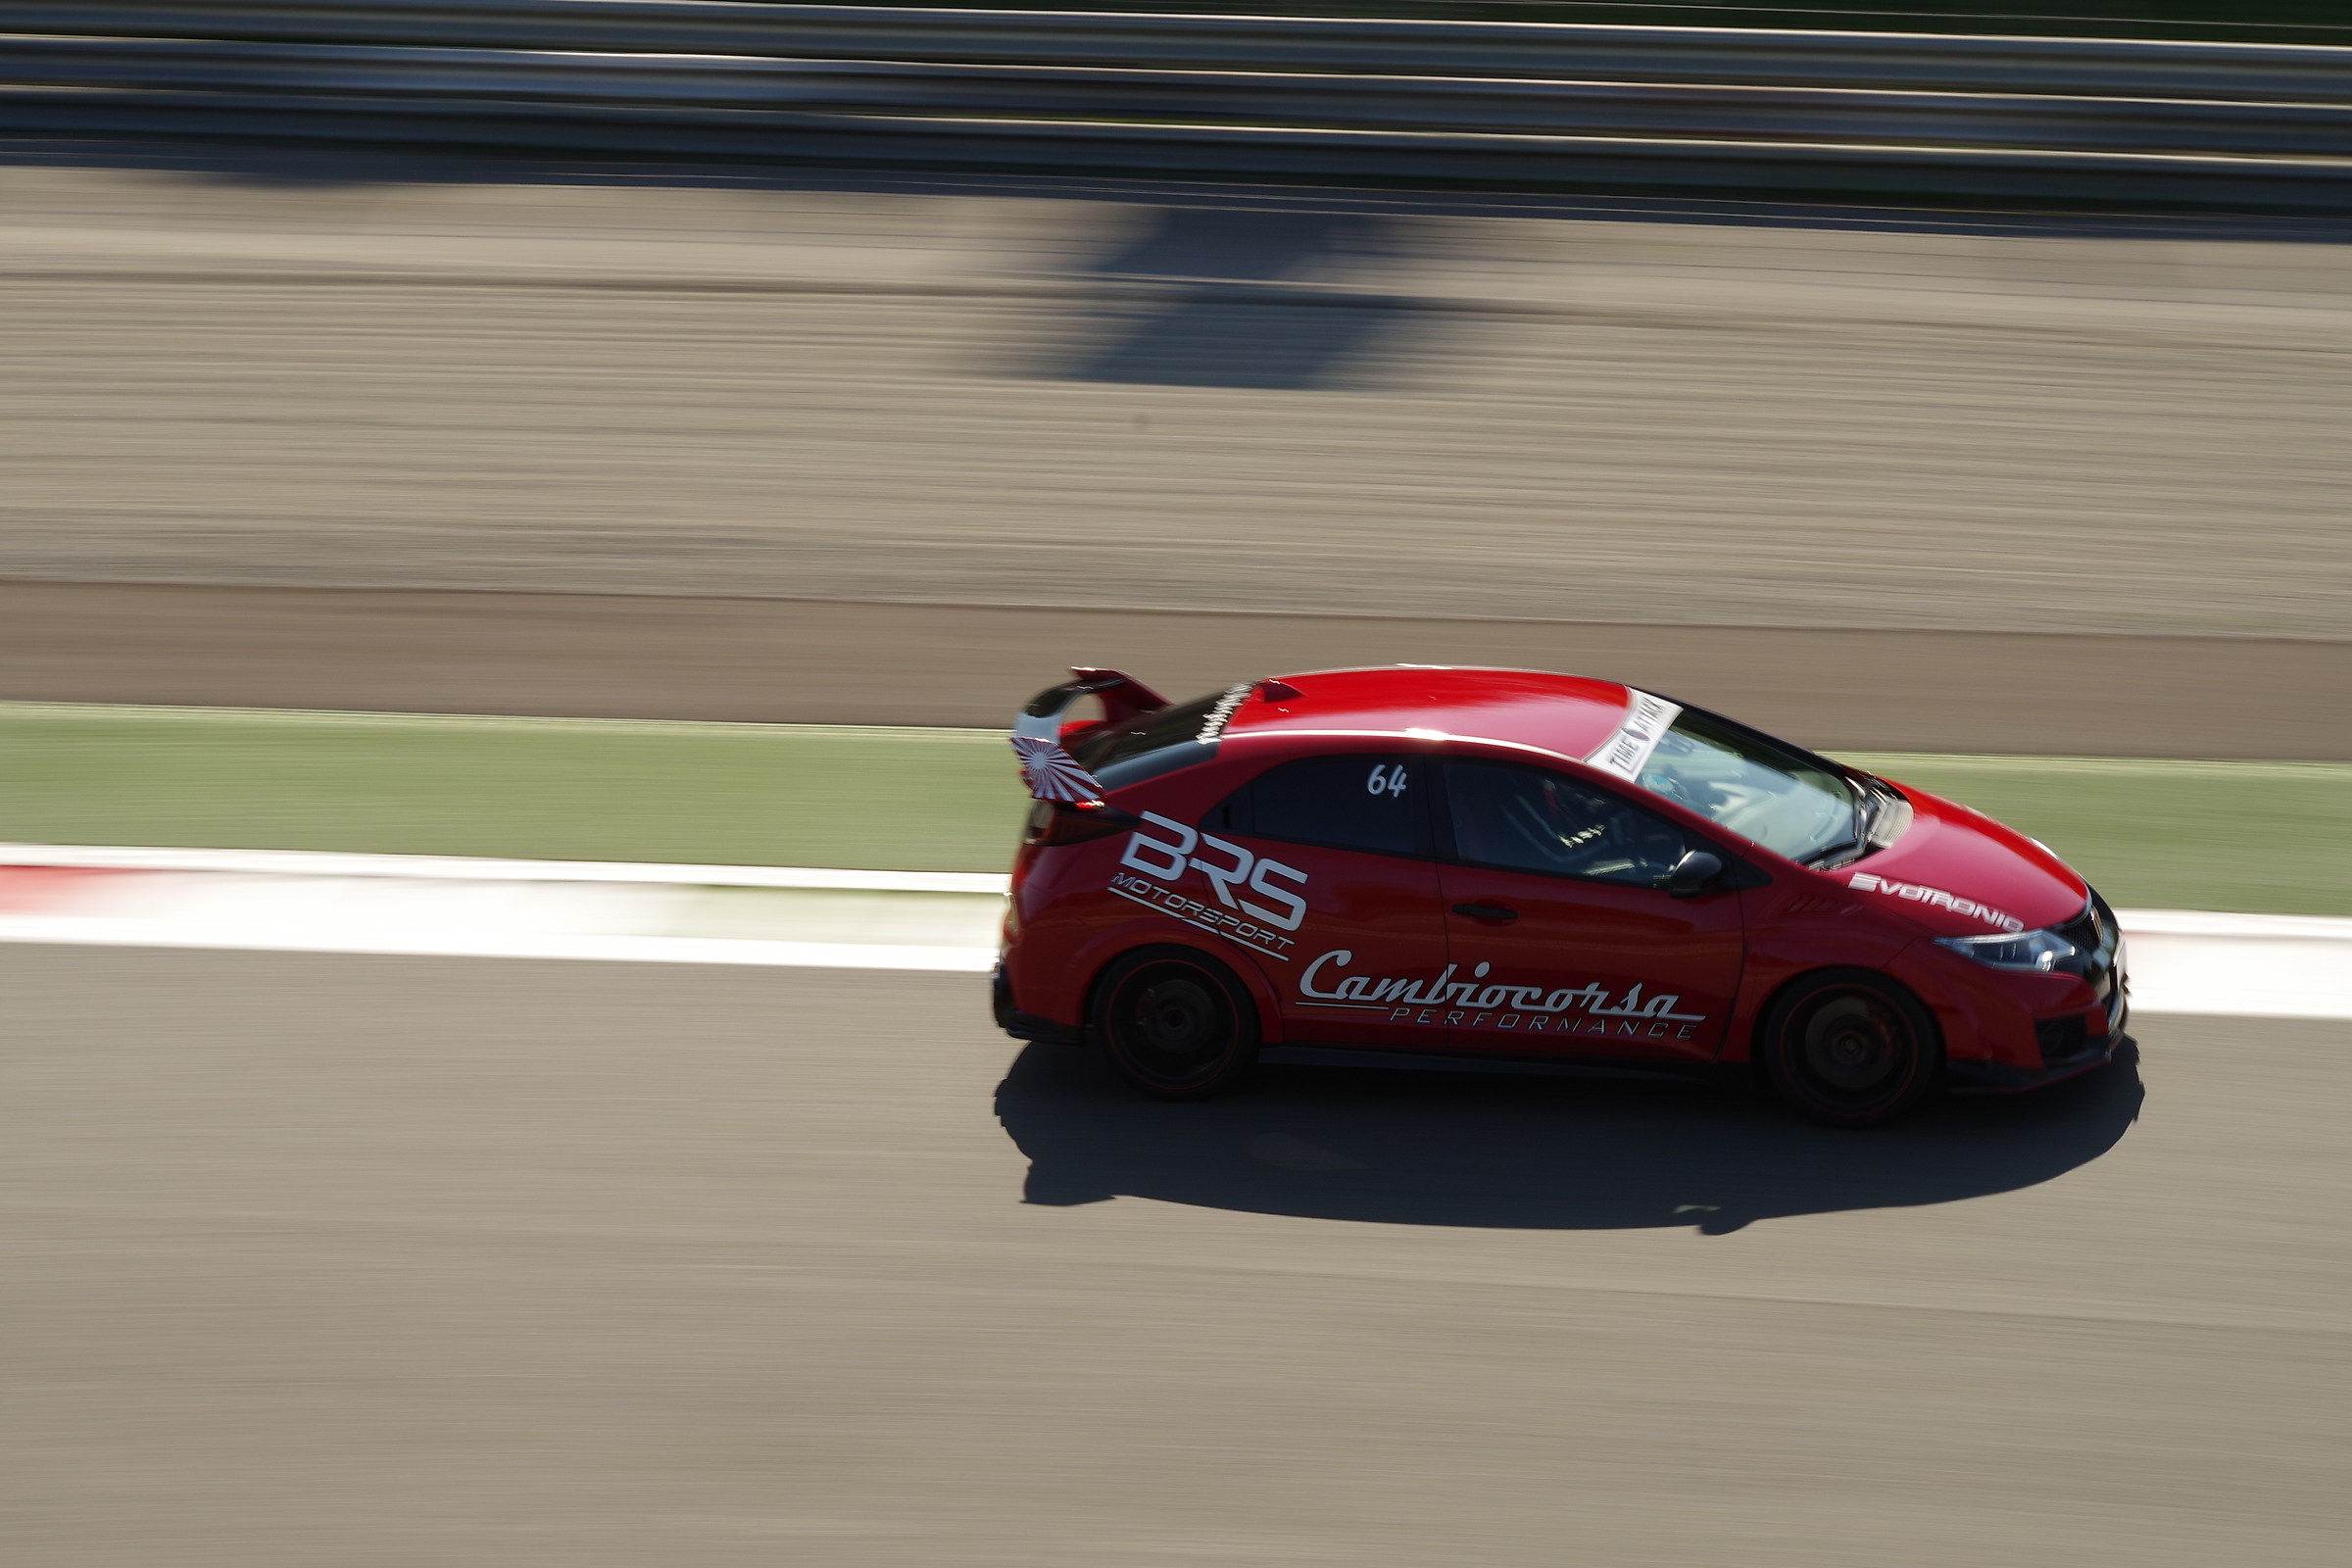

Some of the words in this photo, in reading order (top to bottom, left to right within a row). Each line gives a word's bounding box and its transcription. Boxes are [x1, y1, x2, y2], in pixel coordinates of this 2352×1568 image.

[1367, 763, 1407, 798] 64
[1609, 735, 1640, 774] TIME
[1119, 809, 1309, 931] BRS
[1110, 872, 1296, 950] MOTORSPORT
[1298, 949, 1707, 1022] Cambiocorsa
[1390, 1007, 1698, 1040] PERFORMANCE
